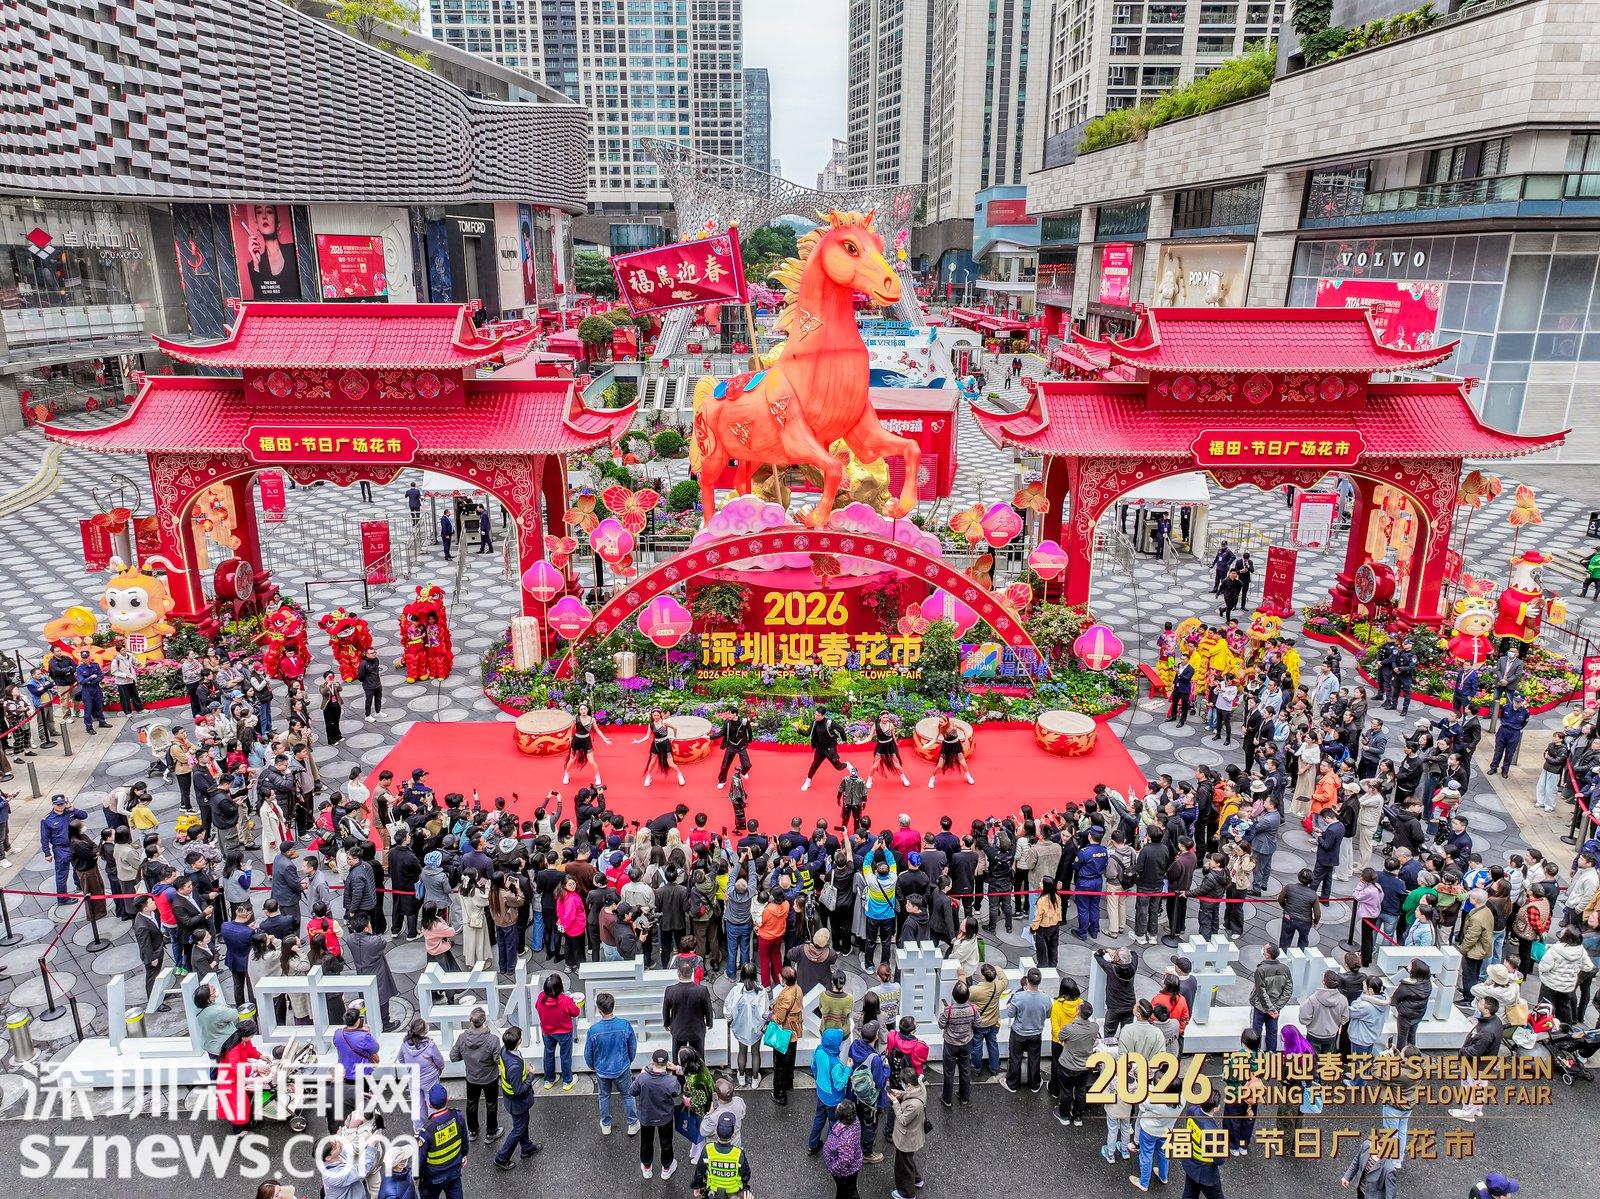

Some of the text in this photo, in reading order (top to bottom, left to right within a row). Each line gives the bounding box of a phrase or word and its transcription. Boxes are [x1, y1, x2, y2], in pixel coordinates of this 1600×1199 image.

[458, 220, 485, 233] TOM FORD
[63, 231, 141, 250] 卓悦中心
[1341, 251, 1426, 267] VOLVO
[628, 254, 729, 294] 福馬迎春
[1188, 271, 1202, 286] POP
[1272, 570, 1287, 579] 入口
[764, 591, 848, 625] 2026
[701, 632, 922, 667] 深圳迎春花市
[697, 670, 719, 679] 2026
[901, 670, 922, 680] FAIR
[712, 1169, 735, 1178] POLICE
